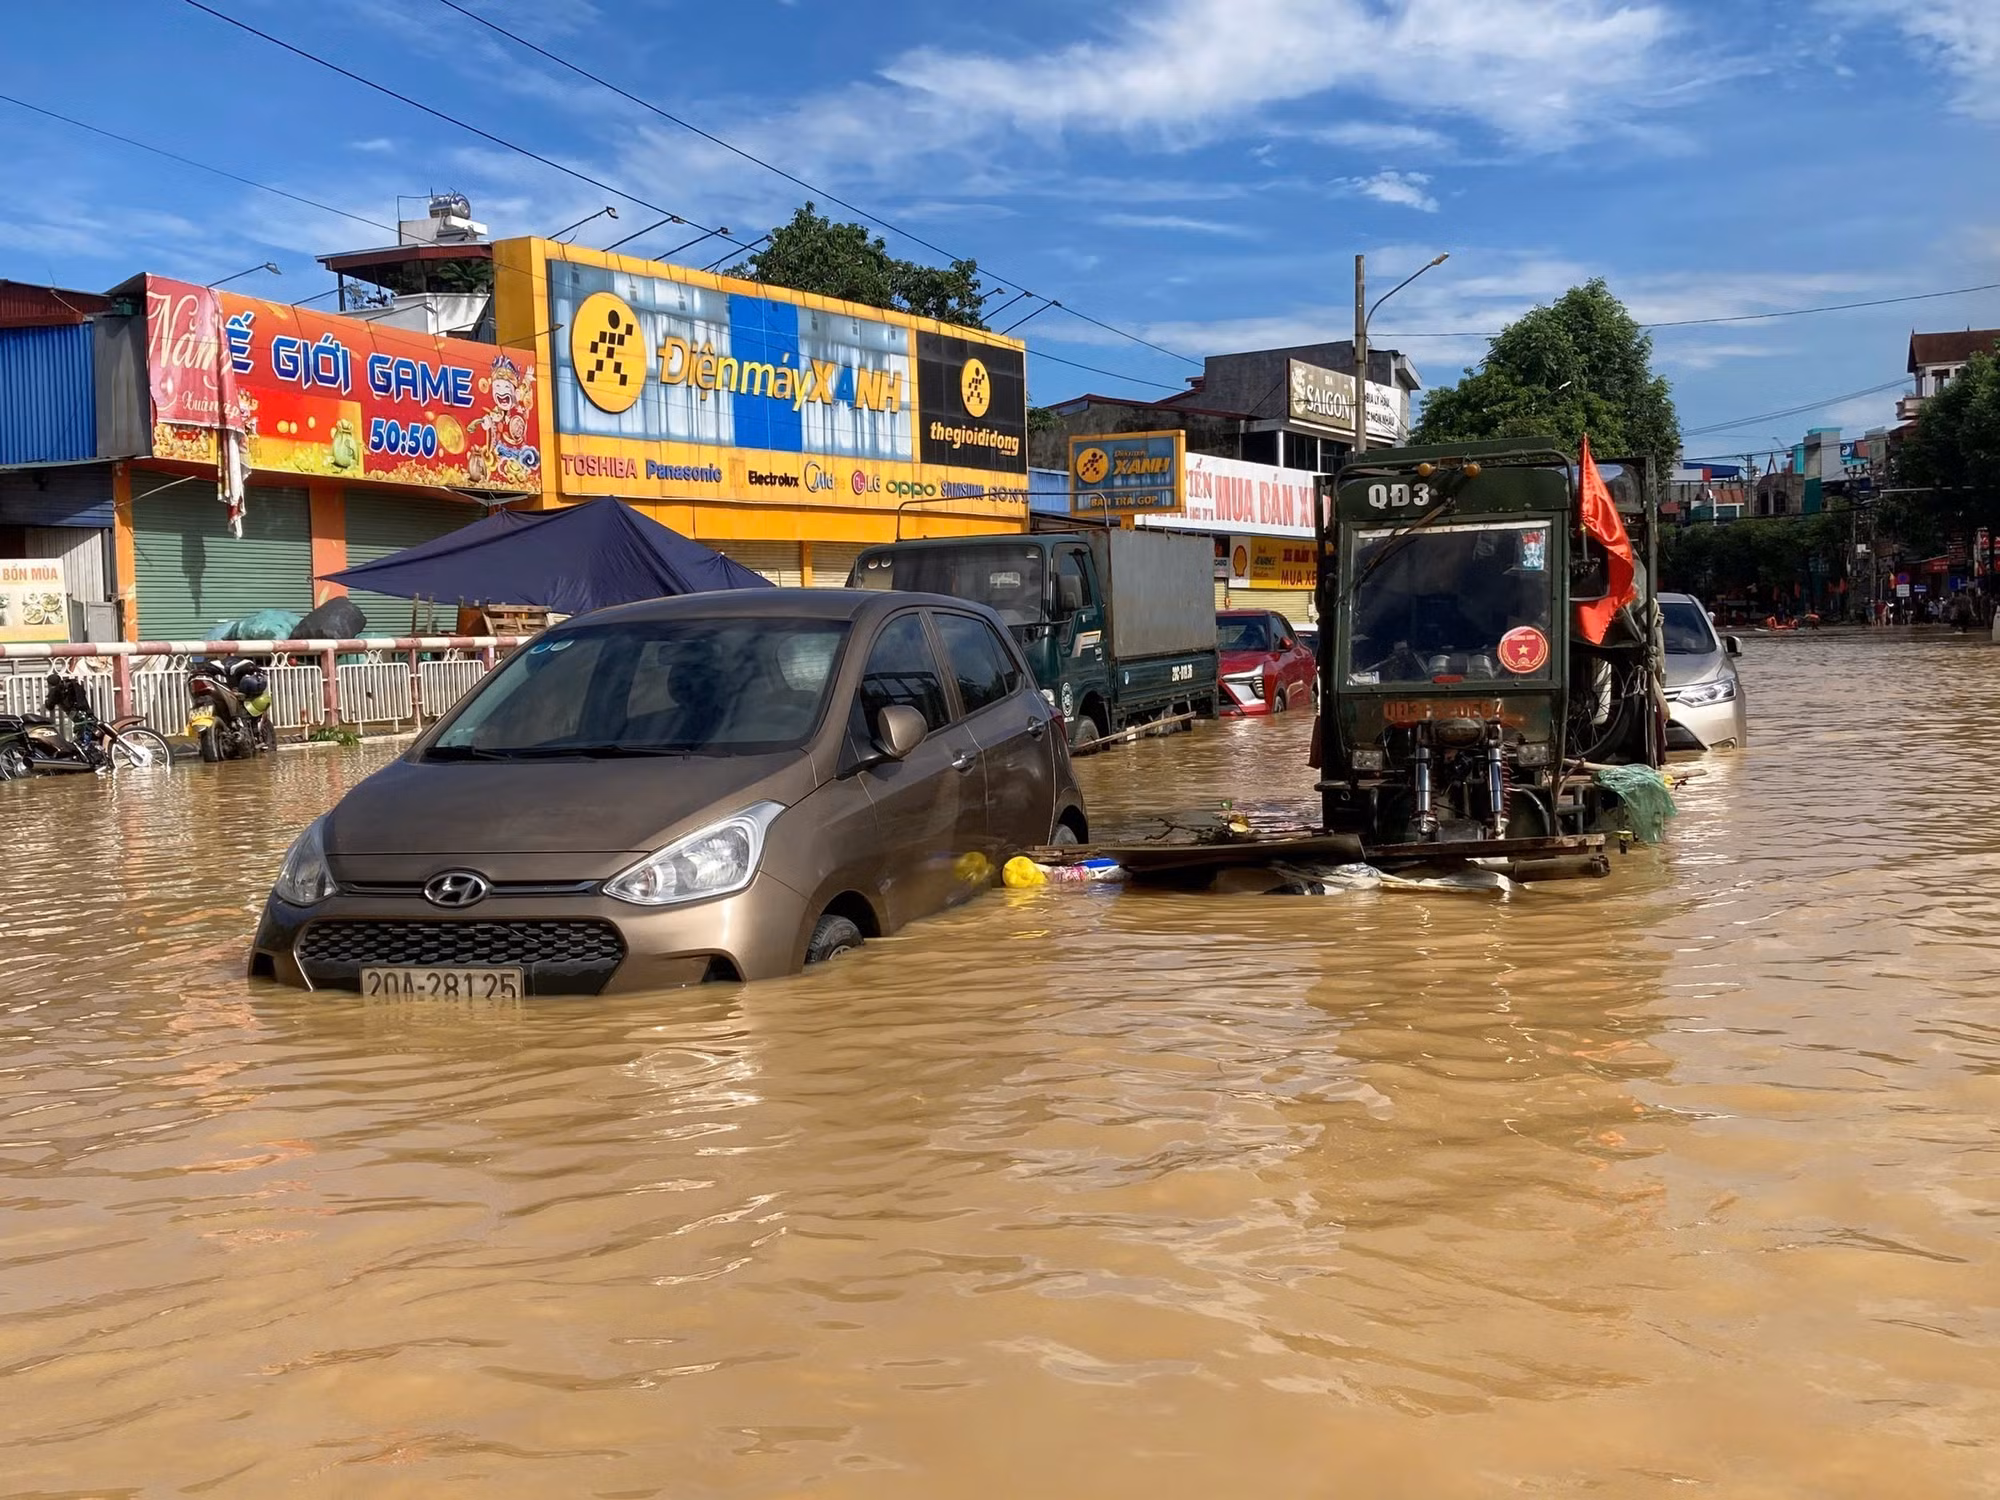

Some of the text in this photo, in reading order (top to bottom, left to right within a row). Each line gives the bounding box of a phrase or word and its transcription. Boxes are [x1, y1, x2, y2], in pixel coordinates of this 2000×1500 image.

[271, 332, 352, 396] GIỚI
[367, 352, 475, 408] GAME
[1306, 384, 1351, 421] SAIGON
[369, 416, 438, 459] 50:50
[930, 421, 1020, 456] thegioididong
[561, 453, 638, 479] TOSHIBA
[645, 458, 723, 483] Panasonic
[748, 469, 800, 488] Electrolux
[1113, 457, 1171, 476] XANH
[940, 480, 984, 500] SAMSUNG
[1215, 475, 1256, 523] MUA
[1259, 473, 1295, 527] BÁN
[1368, 483, 1430, 509] QĐ3
[31, 564, 59, 581] MÙA
[1281, 569, 1303, 586] MUA
